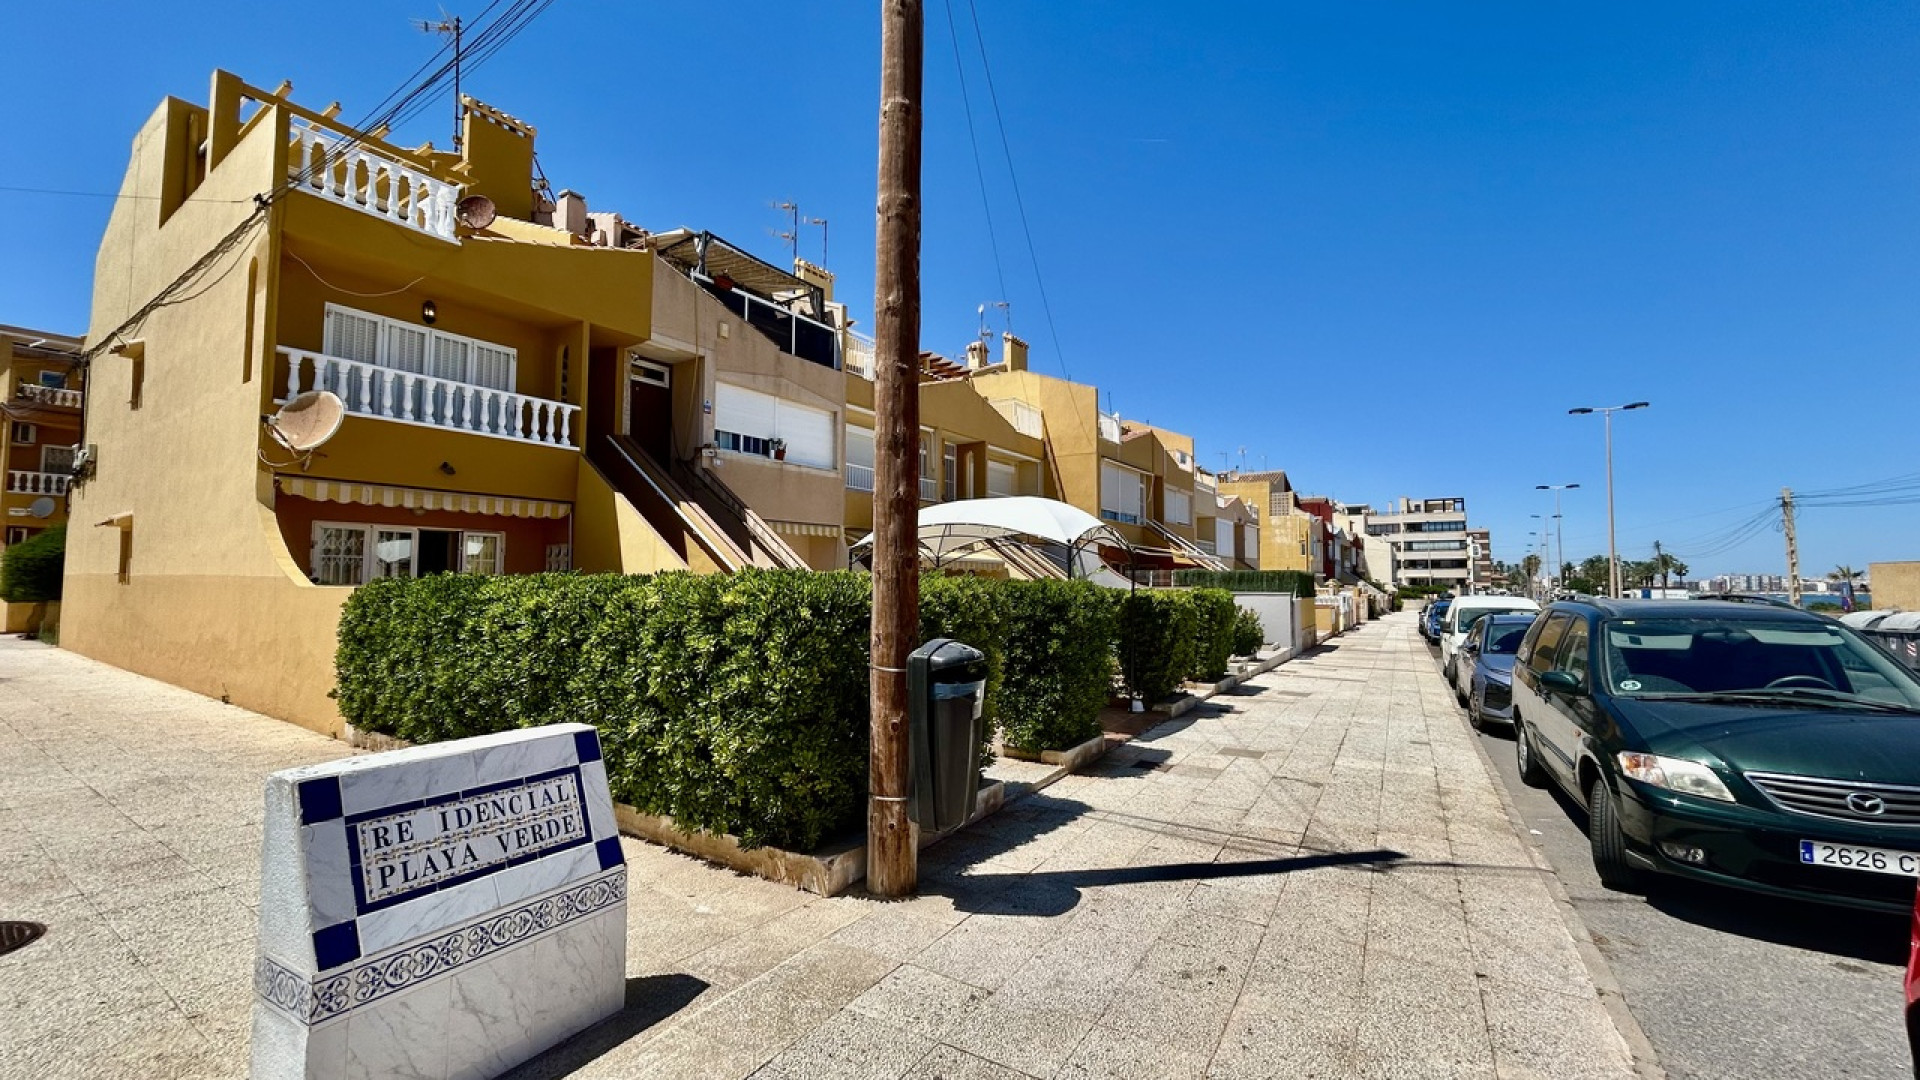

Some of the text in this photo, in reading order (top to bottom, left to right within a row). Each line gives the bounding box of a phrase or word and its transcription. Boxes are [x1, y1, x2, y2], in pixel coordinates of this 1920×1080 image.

[378, 814, 575, 889] PLAYA VERDE
[1822, 845, 1920, 873] 2626 C
